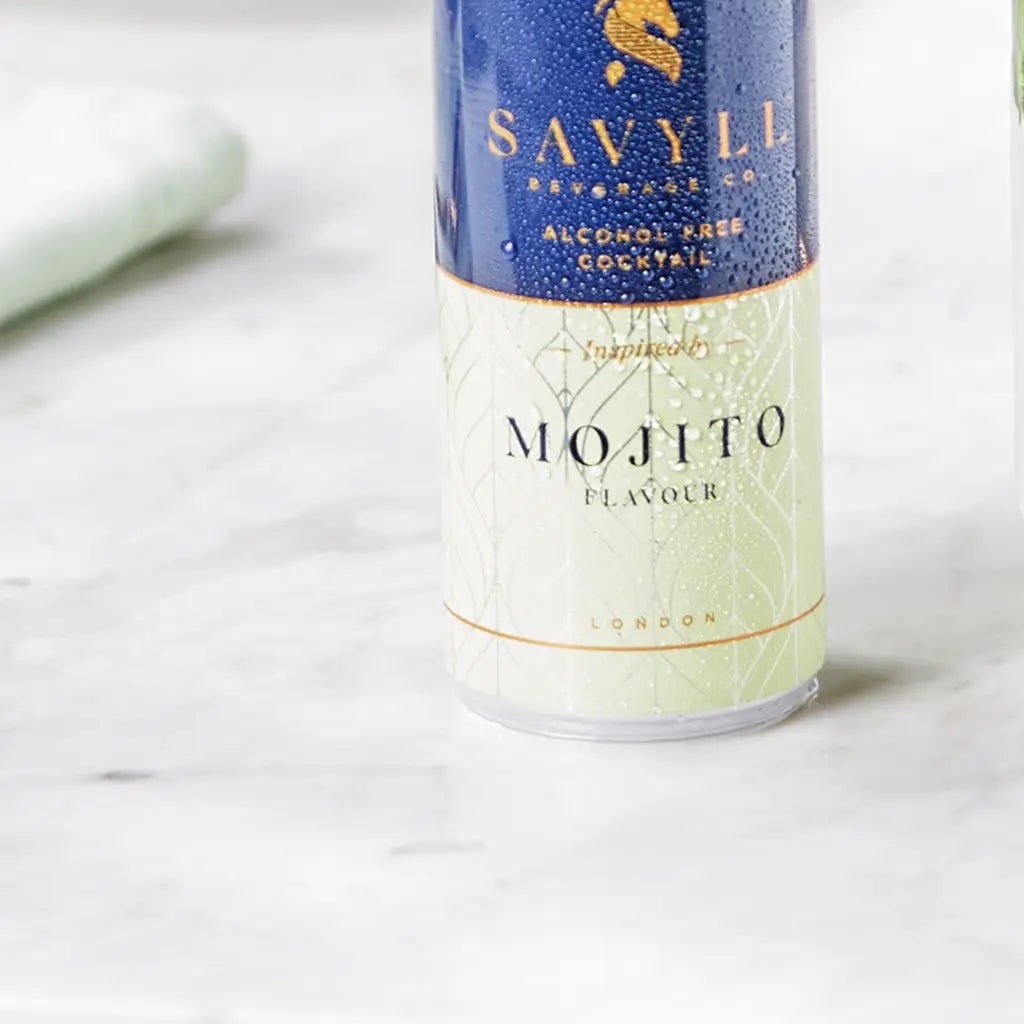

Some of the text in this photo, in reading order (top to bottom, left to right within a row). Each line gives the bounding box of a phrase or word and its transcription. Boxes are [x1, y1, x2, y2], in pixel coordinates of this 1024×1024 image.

[487, 100, 789, 167] SAVYLL
[543, 217, 743, 245] ALCOHOL FREE
[578, 249, 712, 272] COCKTAIL
[581, 337, 683, 364] Inspired
[505, 404, 786, 467] MOJITO
[584, 482, 718, 507] FLAVOUR
[591, 611, 717, 631] LONDON
